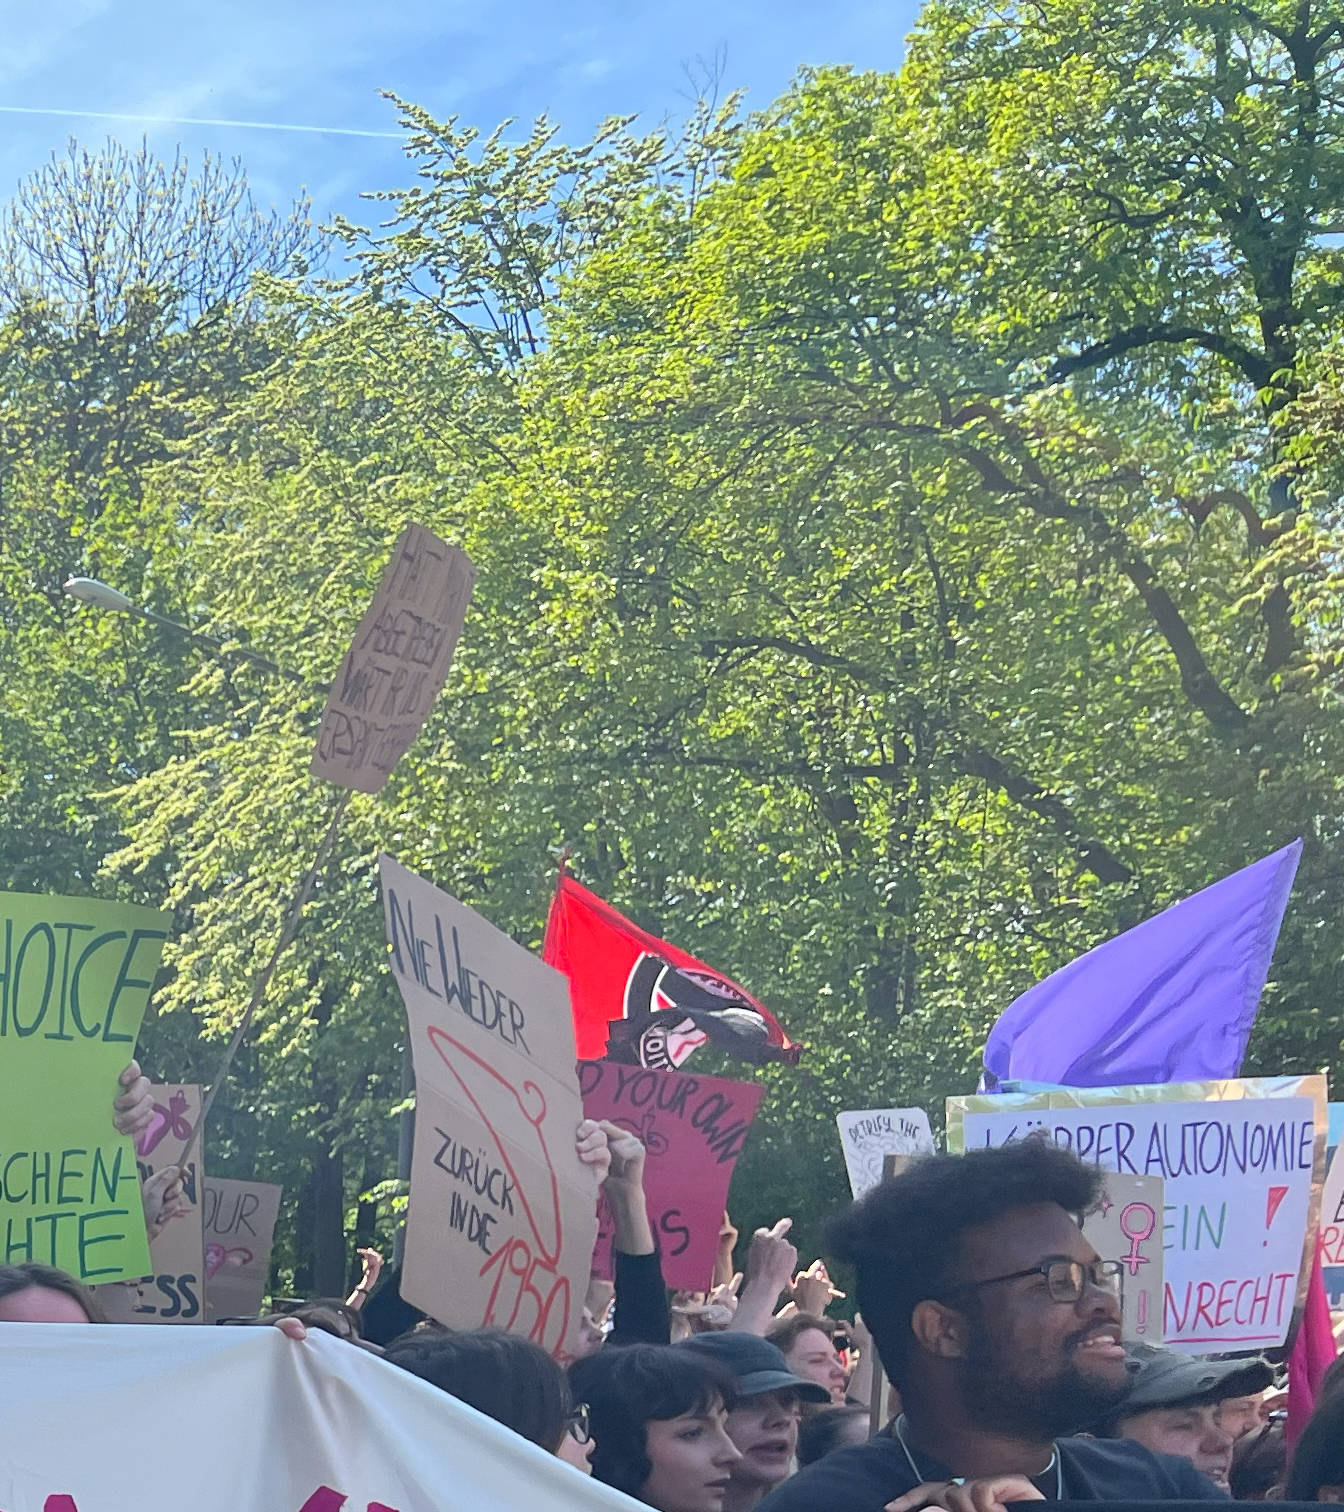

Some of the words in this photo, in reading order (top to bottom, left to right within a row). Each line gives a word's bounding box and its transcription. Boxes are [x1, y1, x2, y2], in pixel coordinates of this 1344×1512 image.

[388, 888, 443, 999] NIE
[435, 914, 532, 1056] WIEDER
[615, 1069, 700, 1120] YOUR
[690, 1089, 753, 1167] OWN
[433, 1126, 515, 1217] ZURÜCK
